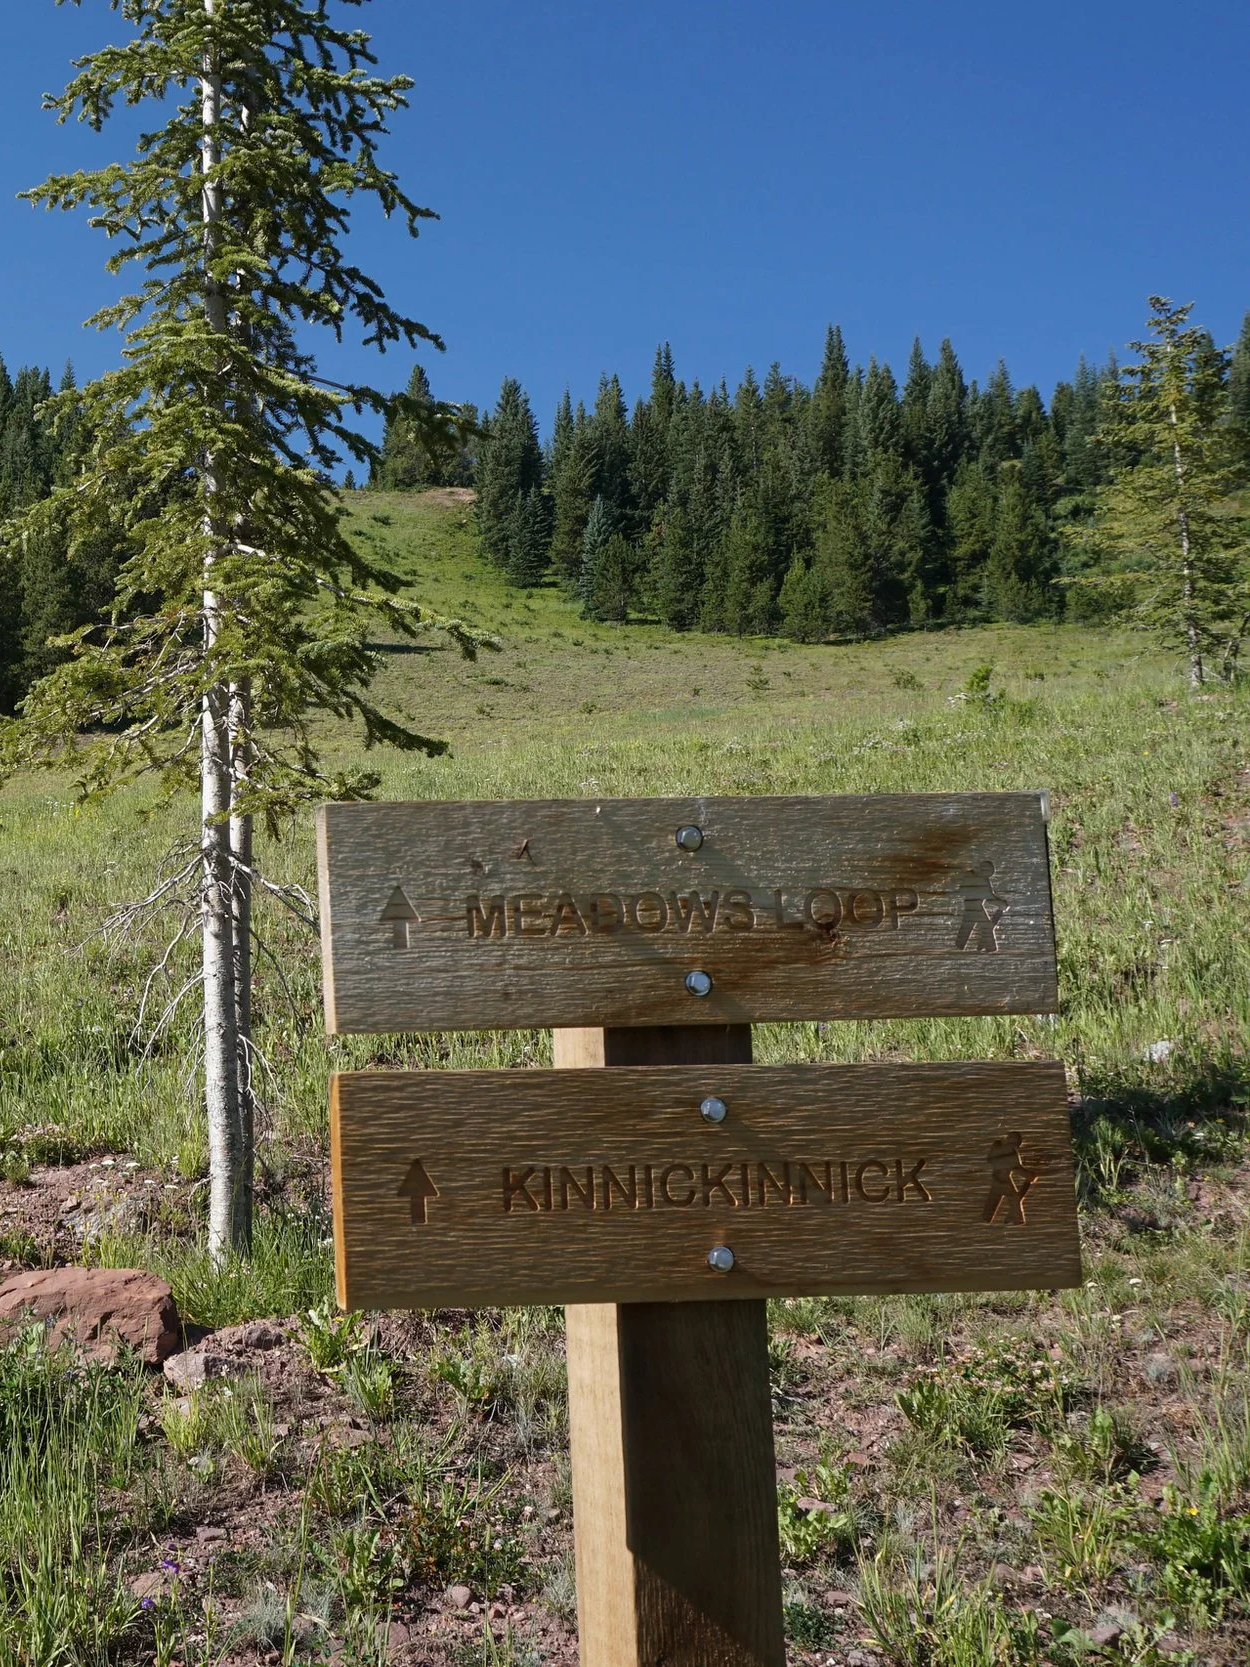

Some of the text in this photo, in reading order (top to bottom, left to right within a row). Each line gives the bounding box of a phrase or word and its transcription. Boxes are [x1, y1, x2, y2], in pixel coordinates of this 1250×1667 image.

[465, 887, 920, 938] MEADOWS LOOP
[503, 1159, 933, 1212] KINNICKINNICK
